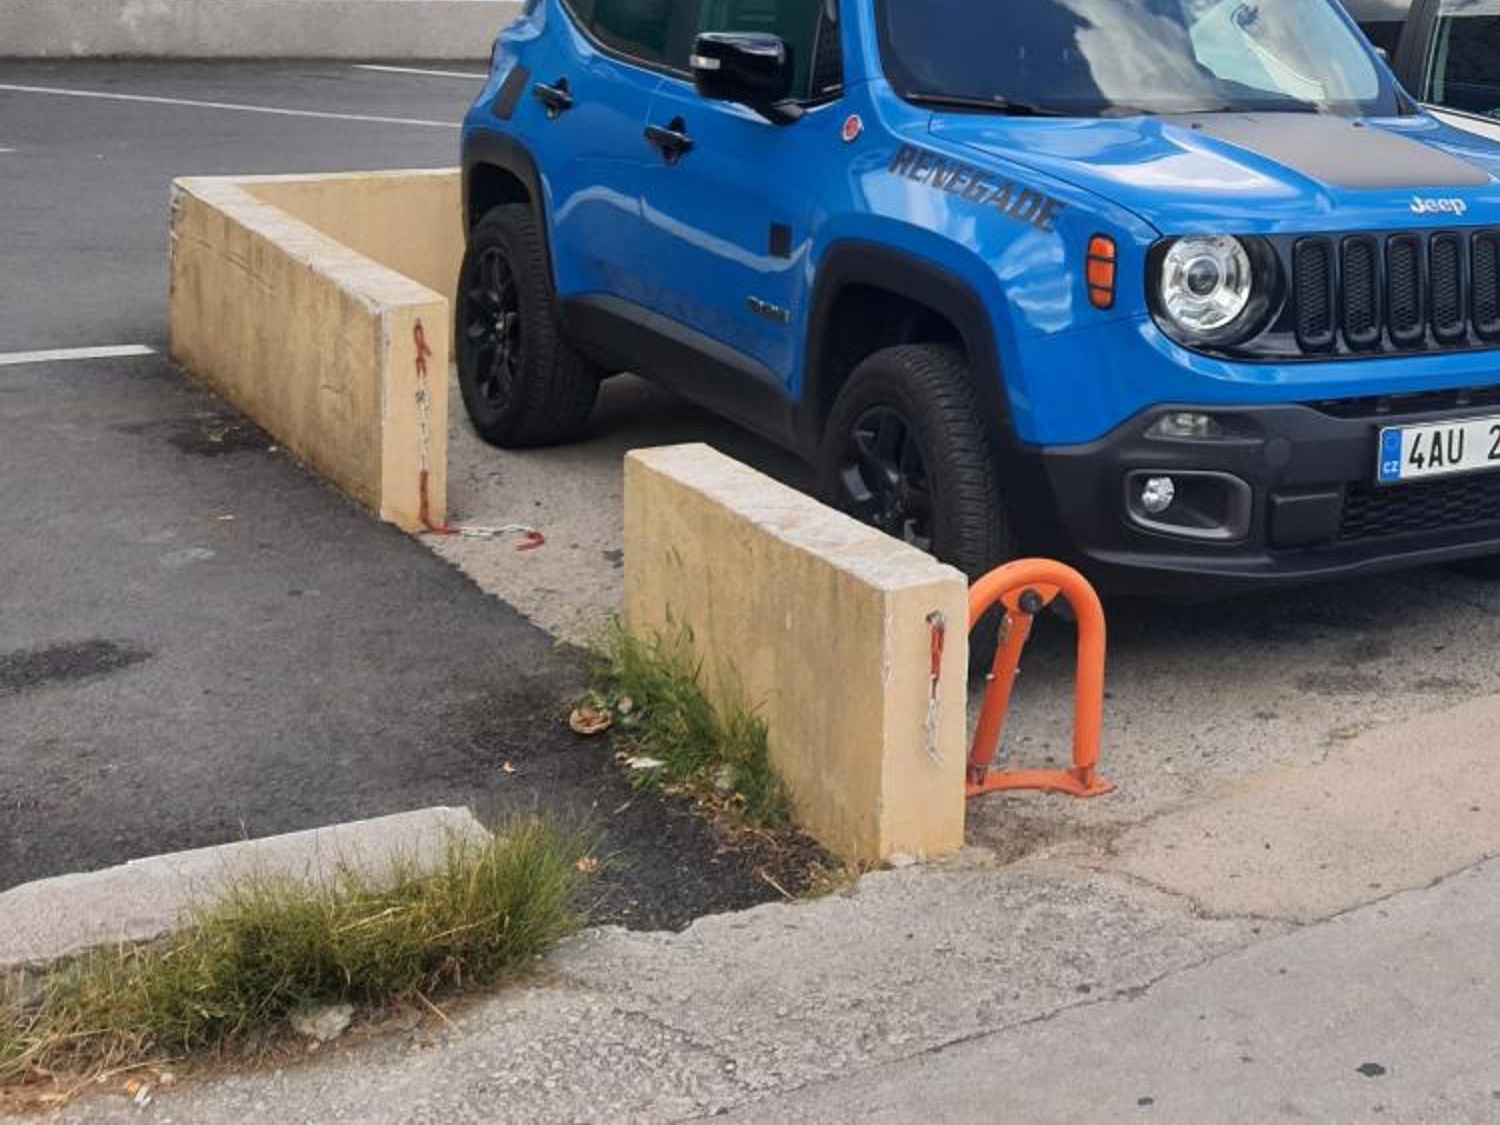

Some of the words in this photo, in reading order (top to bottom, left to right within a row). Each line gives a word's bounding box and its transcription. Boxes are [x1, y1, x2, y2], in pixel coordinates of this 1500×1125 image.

[888, 141, 1067, 234] RENEGADE
[1410, 195, 1467, 216] Jeep
[1408, 428, 1464, 470] 4AU
[1383, 461, 1399, 474] CZ
